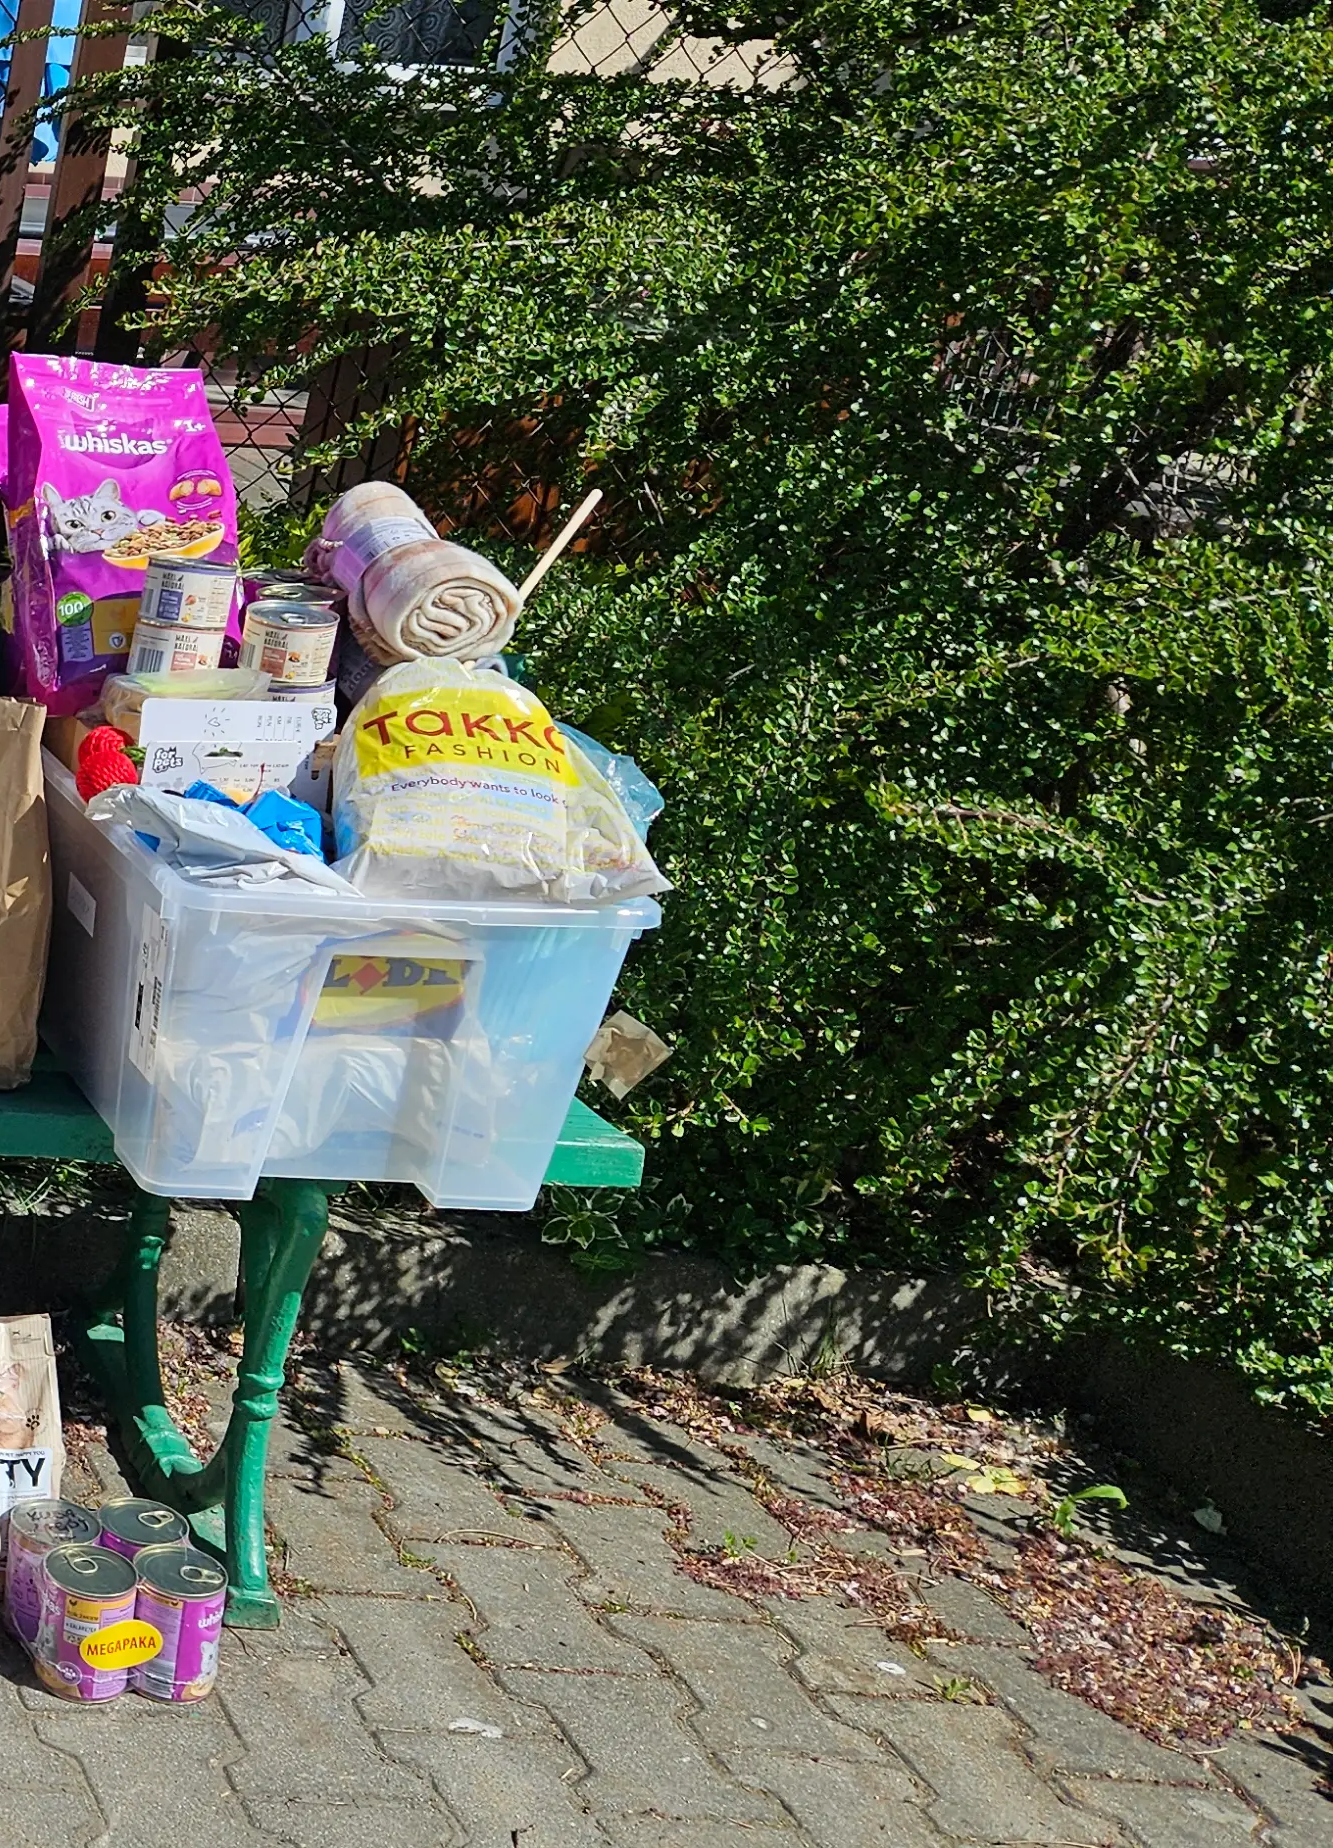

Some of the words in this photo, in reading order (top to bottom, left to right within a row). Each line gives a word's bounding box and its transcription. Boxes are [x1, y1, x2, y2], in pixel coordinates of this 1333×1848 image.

[64, 431, 167, 454] whiskas
[153, 755, 183, 770] pets
[155, 749, 176, 759] for
[405, 743, 561, 774] FASHION
[391, 777, 466, 793] Everybody
[467, 779, 509, 793] wants
[513, 785, 528, 796] to
[530, 788, 559, 805] look
[87, 1636, 157, 1656] MEGAPAKA
